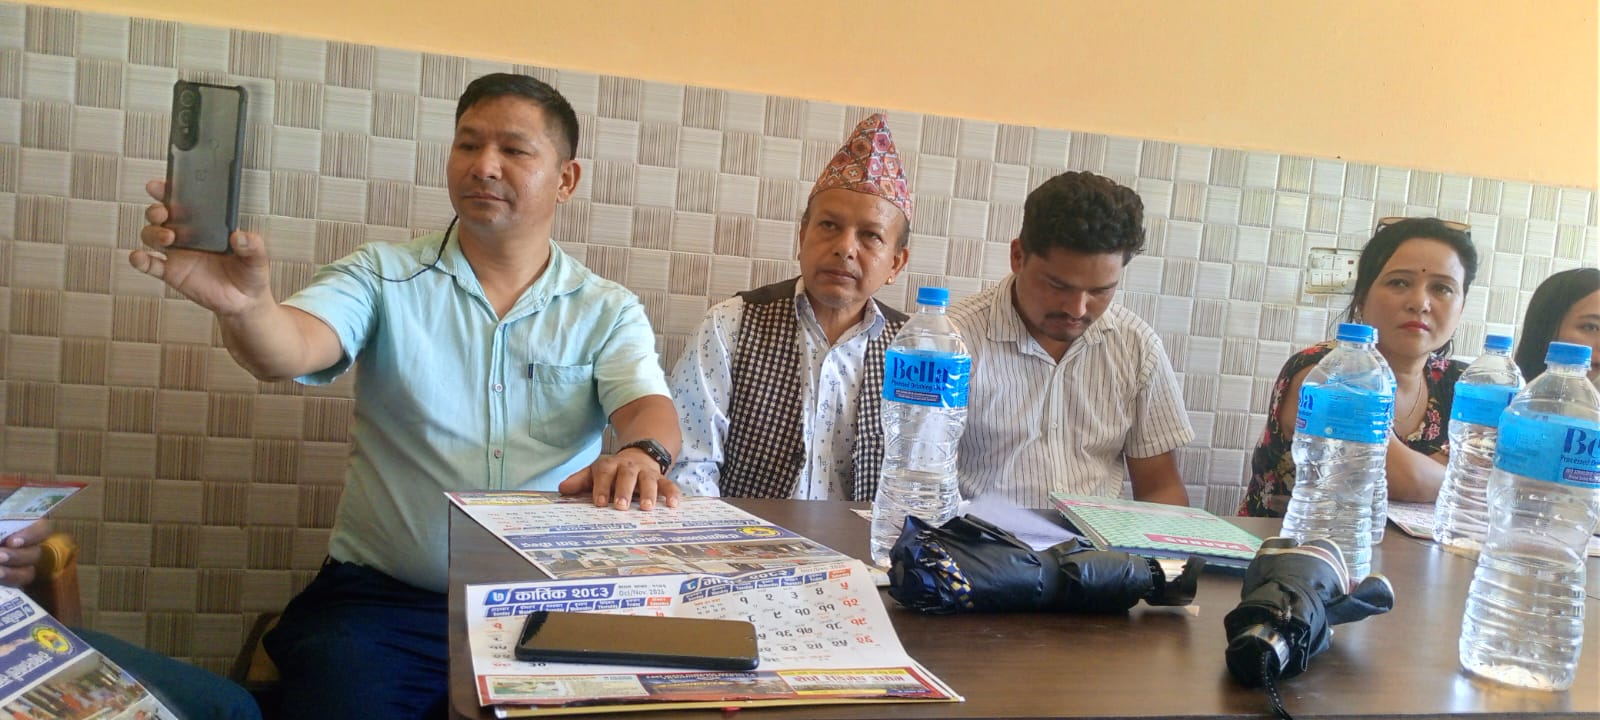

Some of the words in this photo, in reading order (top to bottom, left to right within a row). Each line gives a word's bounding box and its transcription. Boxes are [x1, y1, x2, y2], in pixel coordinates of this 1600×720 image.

[893, 357, 949, 383] Bella
[515, 587, 567, 601] कार्तिक
[572, 587, 610, 599] २०८३
[740, 596, 749, 605] १
[765, 593, 774, 601] २
[791, 591, 799, 599] ३
[815, 587, 824, 595] ४
[794, 607, 811, 617] १०
[818, 603, 835, 612] ११
[842, 598, 858, 608] १२
[775, 629, 793, 638] १६
[796, 627, 813, 635] १७
[825, 622, 843, 631] १८
